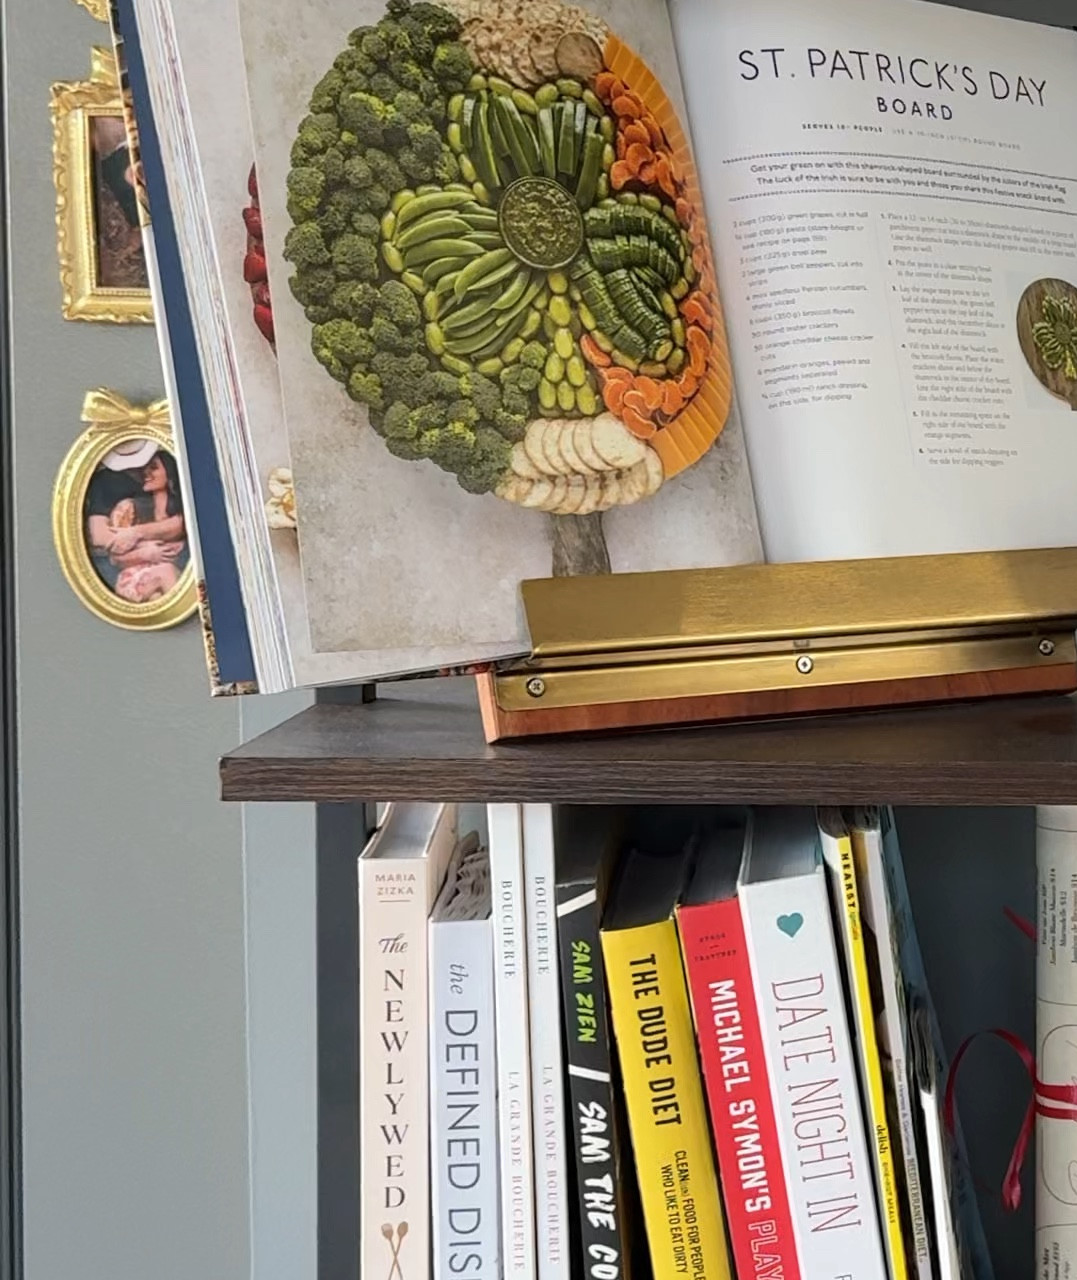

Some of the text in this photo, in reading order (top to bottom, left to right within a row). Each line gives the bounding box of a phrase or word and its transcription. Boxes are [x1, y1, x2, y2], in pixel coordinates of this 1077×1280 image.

[739, 48, 1047, 107] ST. PATRICK'S DAY
[876, 96, 953, 121] BOARD
[757, 177, 773, 185] The
[768, 163, 788, 172] your
[790, 162, 812, 171] green
[375, 873, 416, 896] MARIA ZIZKA
[841, 853, 856, 908] HEARST
[378, 932, 408, 953] The
[449, 963, 468, 995] the
[572, 940, 597, 1043] SAM ZIEN
[629, 953, 682, 1126] THE DUDE DIET
[708, 979, 751, 1093] MICHAEL
[380, 968, 410, 1210] NEWLYWED
[445, 1009, 481, 1190] DEFINED
[502, 880, 525, 1271] BOUCHERIE LA GRANDE BOUCHERIE
[535, 876, 560, 1265] BOUCHERIE LA GRANDE BOUCHERIE
[578, 1101, 611, 1164] SAM
[771, 973, 861, 1233] DATE NIGHT IN
[729, 1099, 772, 1213] SYMON'S
[876, 1124, 889, 1154] delish
[584, 1173, 616, 1231] THE
[661, 1164, 688, 1274] WHO LIKE TO EAT DIRTY
[683, 1198, 697, 1224] FOOD
[907, 1157, 923, 1235] MEDITERRANEAN
[687, 1225, 701, 1245] FOR
